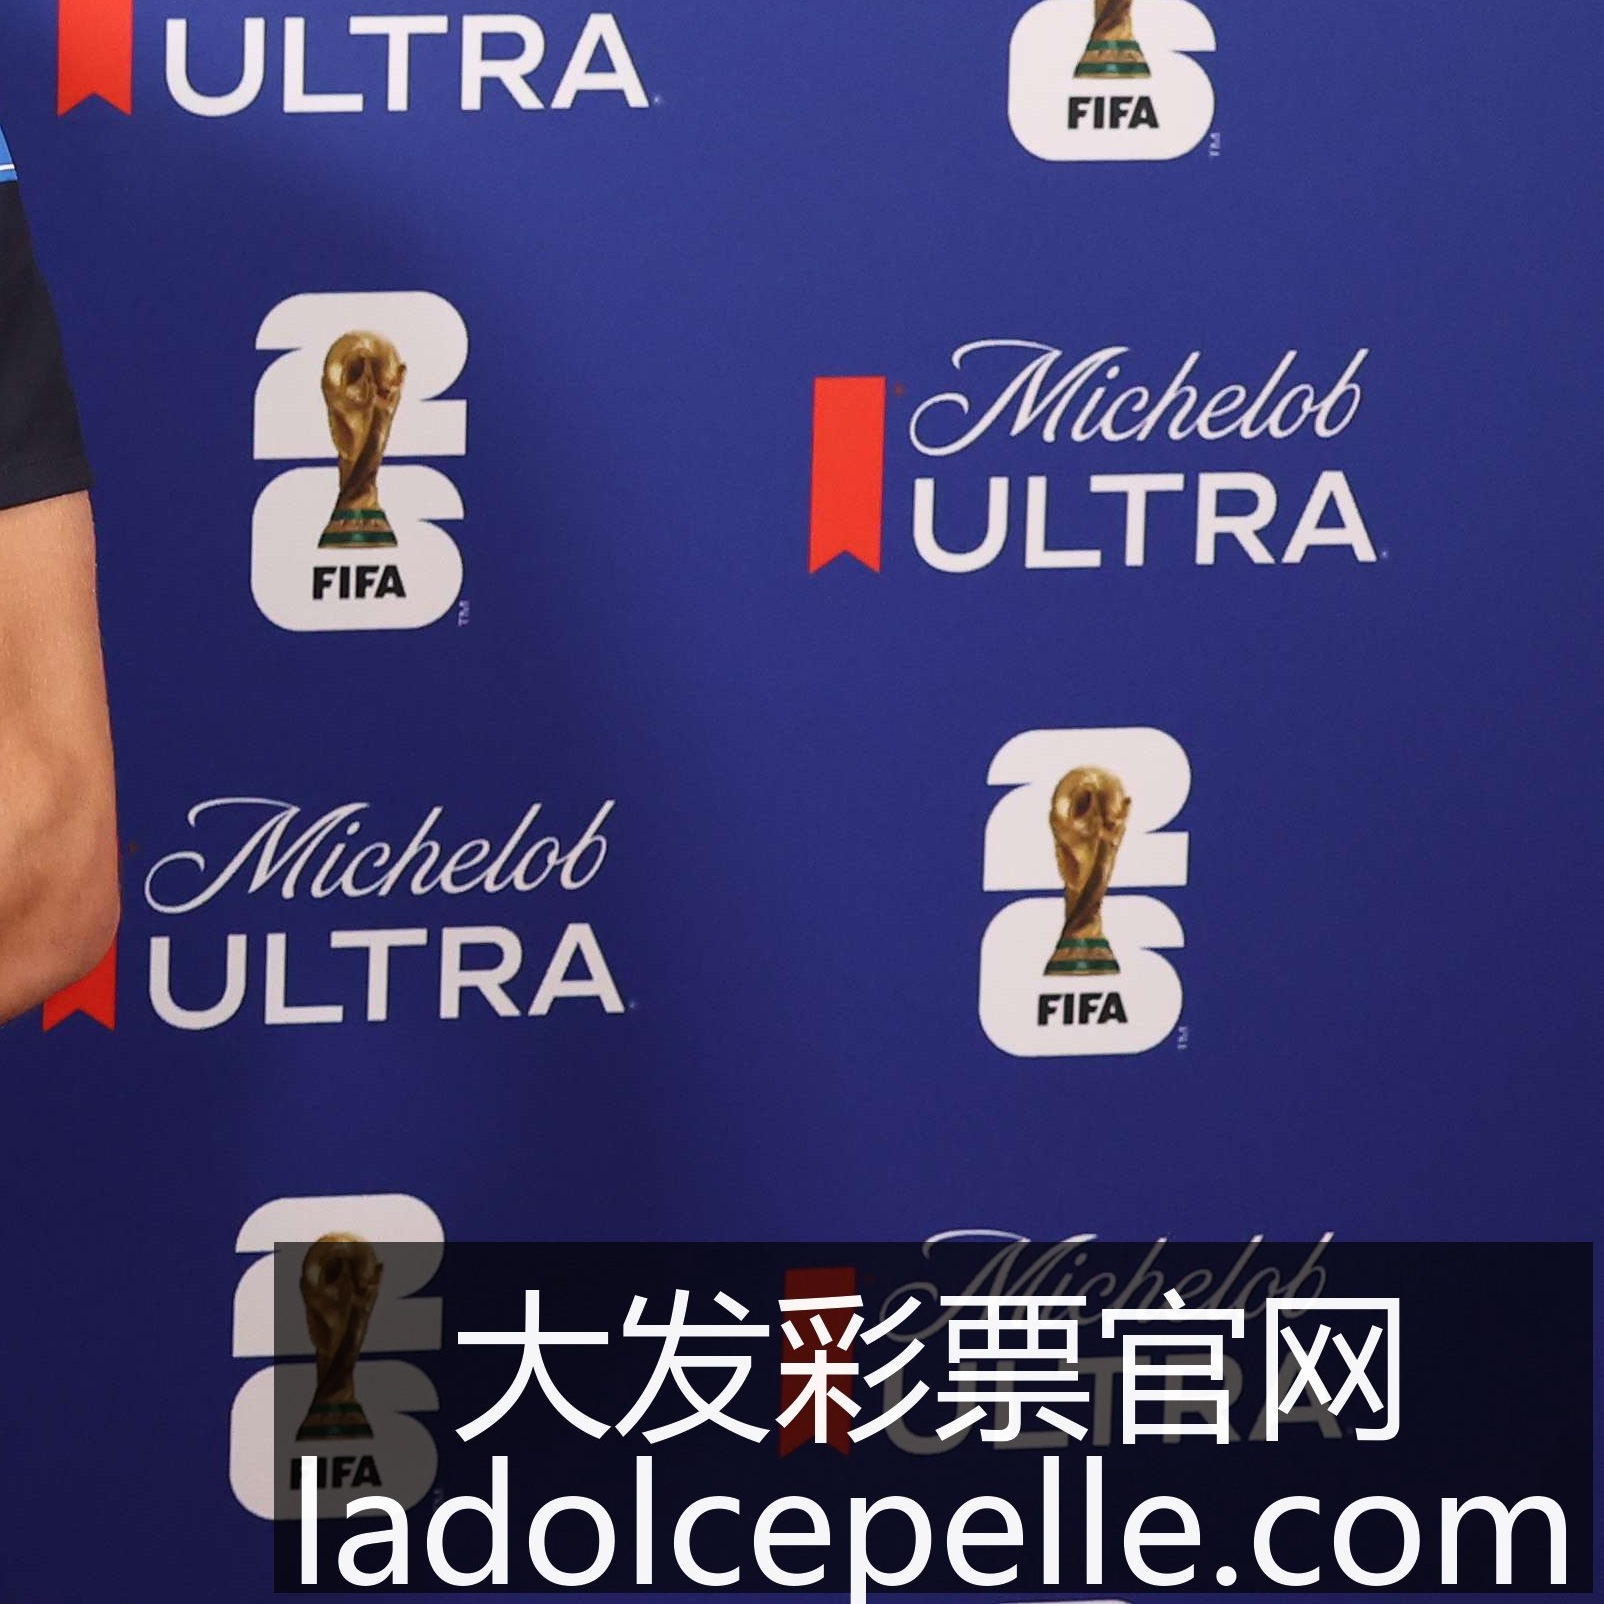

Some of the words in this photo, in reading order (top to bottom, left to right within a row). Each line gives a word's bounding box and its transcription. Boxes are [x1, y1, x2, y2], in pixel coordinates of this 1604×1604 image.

[166, 14, 648, 116] ULTRA
[1068, 96, 1159, 129] FIFA
[910, 340, 1368, 456] Michelob
[914, 471, 1376, 572] ULTRA
[313, 565, 406, 600] FIFA
[145, 798, 614, 913] Michelob
[150, 923, 624, 1029] ULTRA
[1038, 992, 1128, 1026] FIFA
